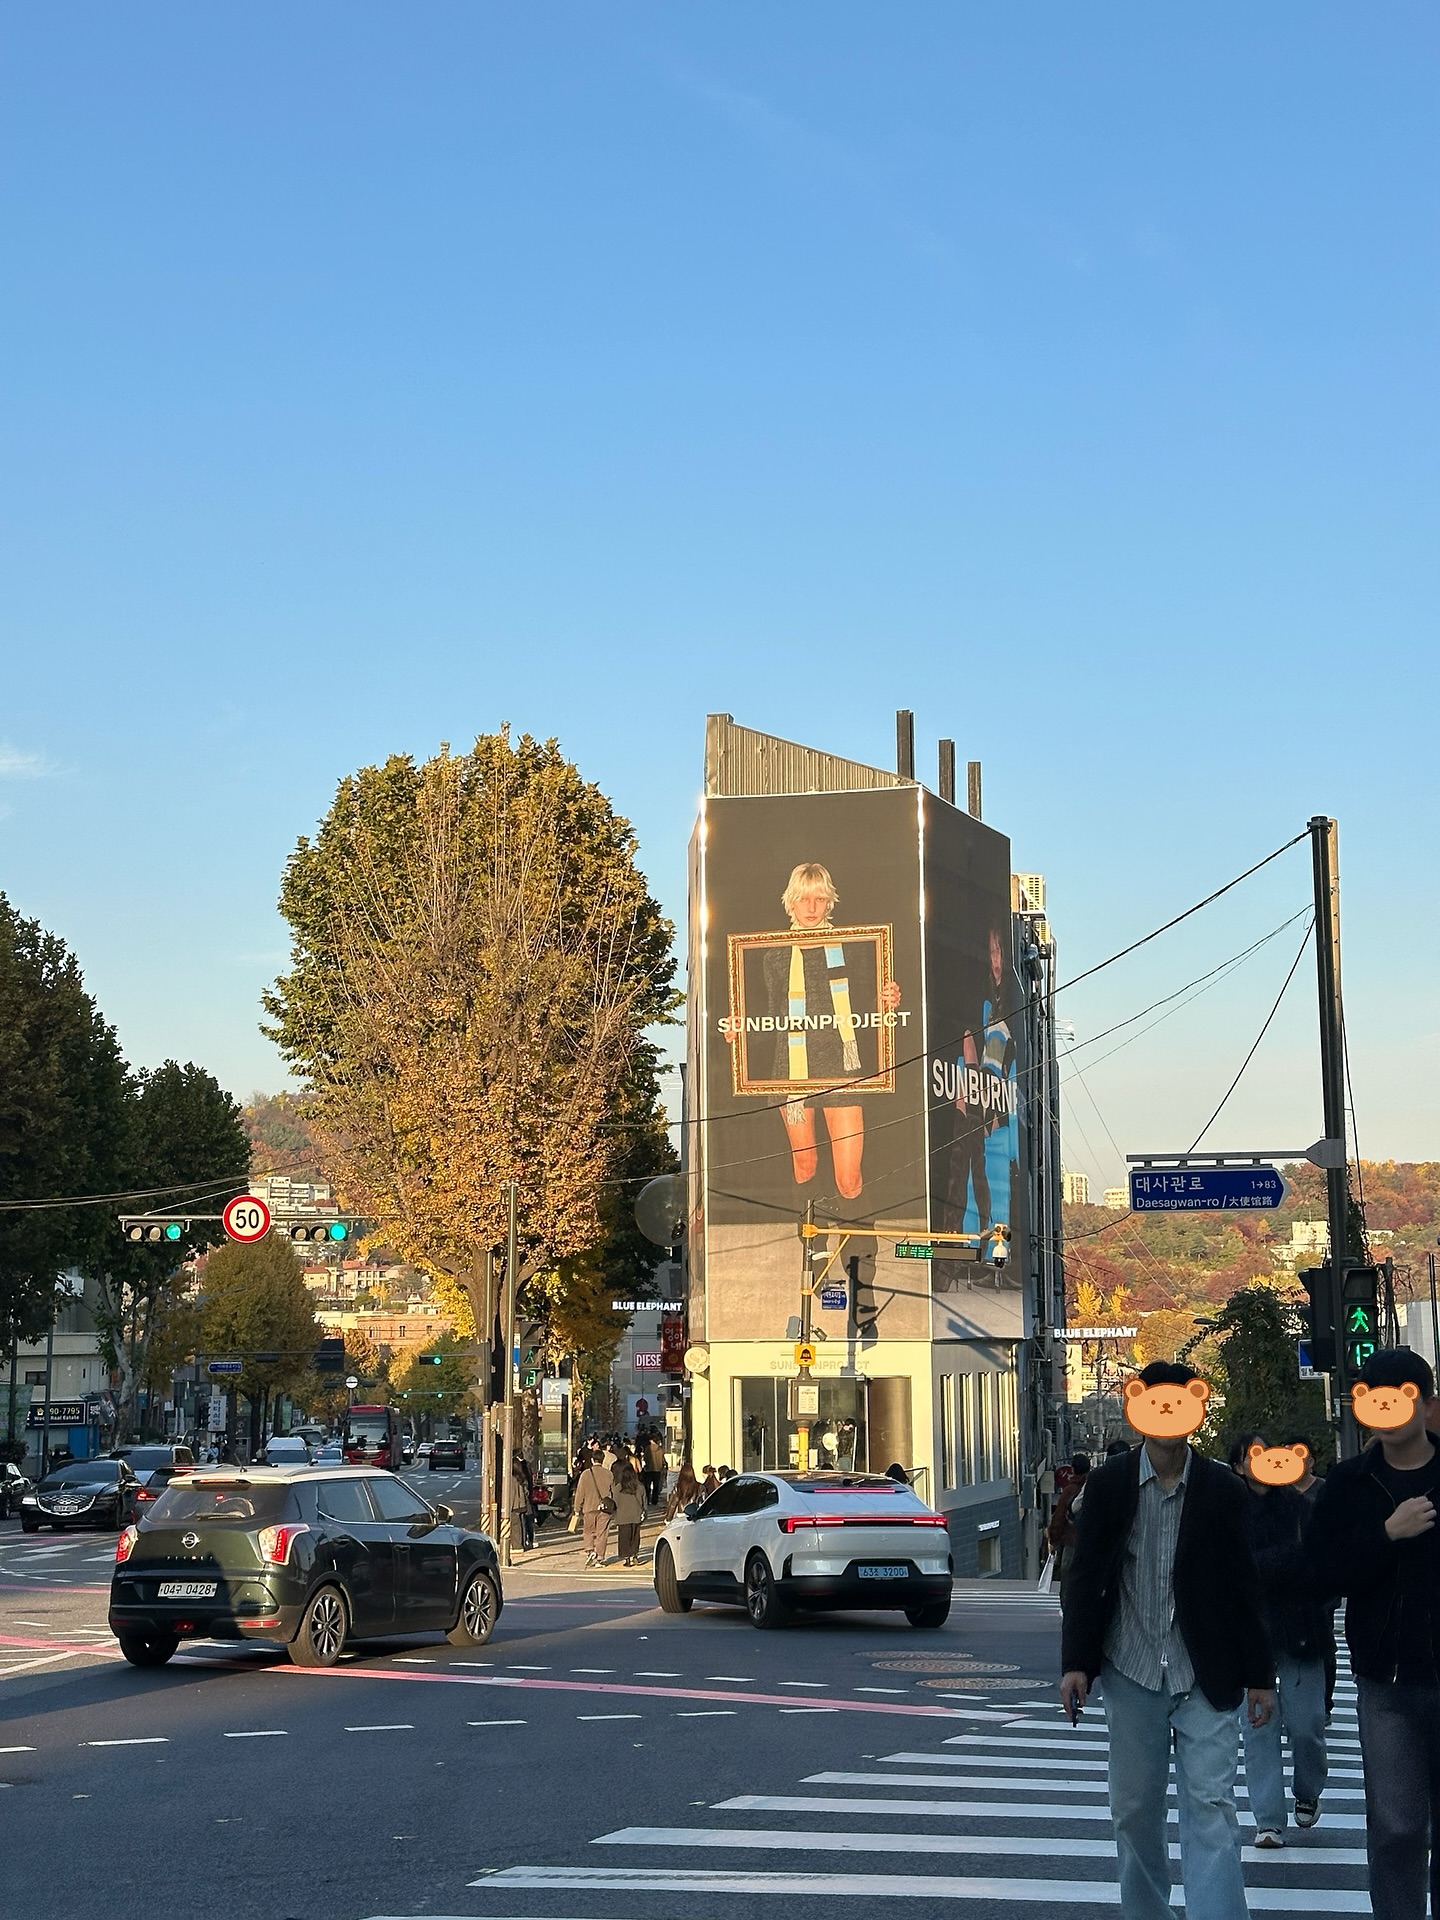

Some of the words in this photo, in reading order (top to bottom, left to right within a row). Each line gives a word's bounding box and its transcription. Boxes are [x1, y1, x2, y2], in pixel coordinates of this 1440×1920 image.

[717, 1012, 911, 1033] SUNBURNPROJECT
[1135, 1176, 1205, 1193] 대사관로
[1136, 1197, 1219, 1210] Daesagwan-ro
[236, 1209, 259, 1229] 50
[611, 1301, 635, 1310] BLUE
[636, 1302, 683, 1311] ELEPHANT
[1054, 1328, 1081, 1338] BLUE
[1083, 1326, 1138, 1338] ELEPHANT
[636, 1354, 661, 1367] DIESE
[49, 1407, 80, 1415] 90-7795
[883, 1567, 904, 1577] 3200
[185, 1584, 212, 1595] 0428
